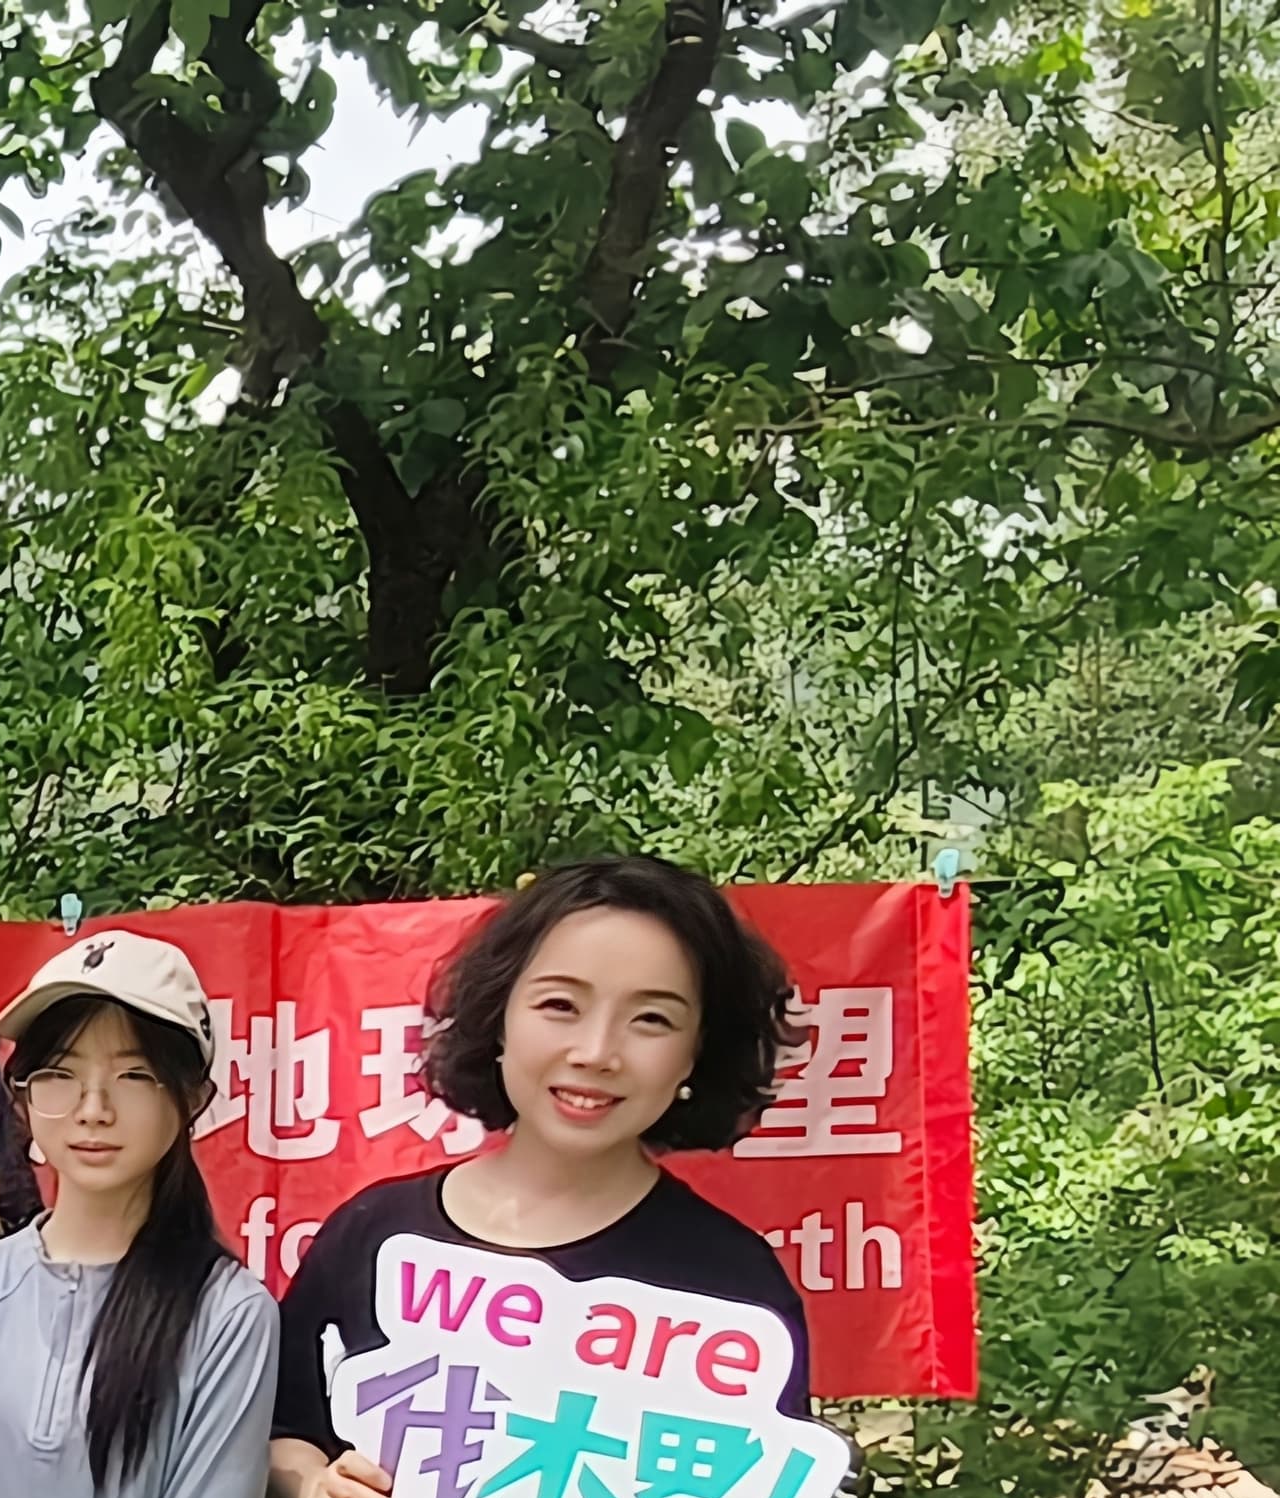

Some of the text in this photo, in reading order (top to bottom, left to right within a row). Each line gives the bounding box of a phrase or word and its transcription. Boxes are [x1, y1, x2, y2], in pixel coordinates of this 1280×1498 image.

[733, 985, 903, 1158] 望
[764, 1201, 903, 1291] th
[401, 1261, 761, 1396] we are
